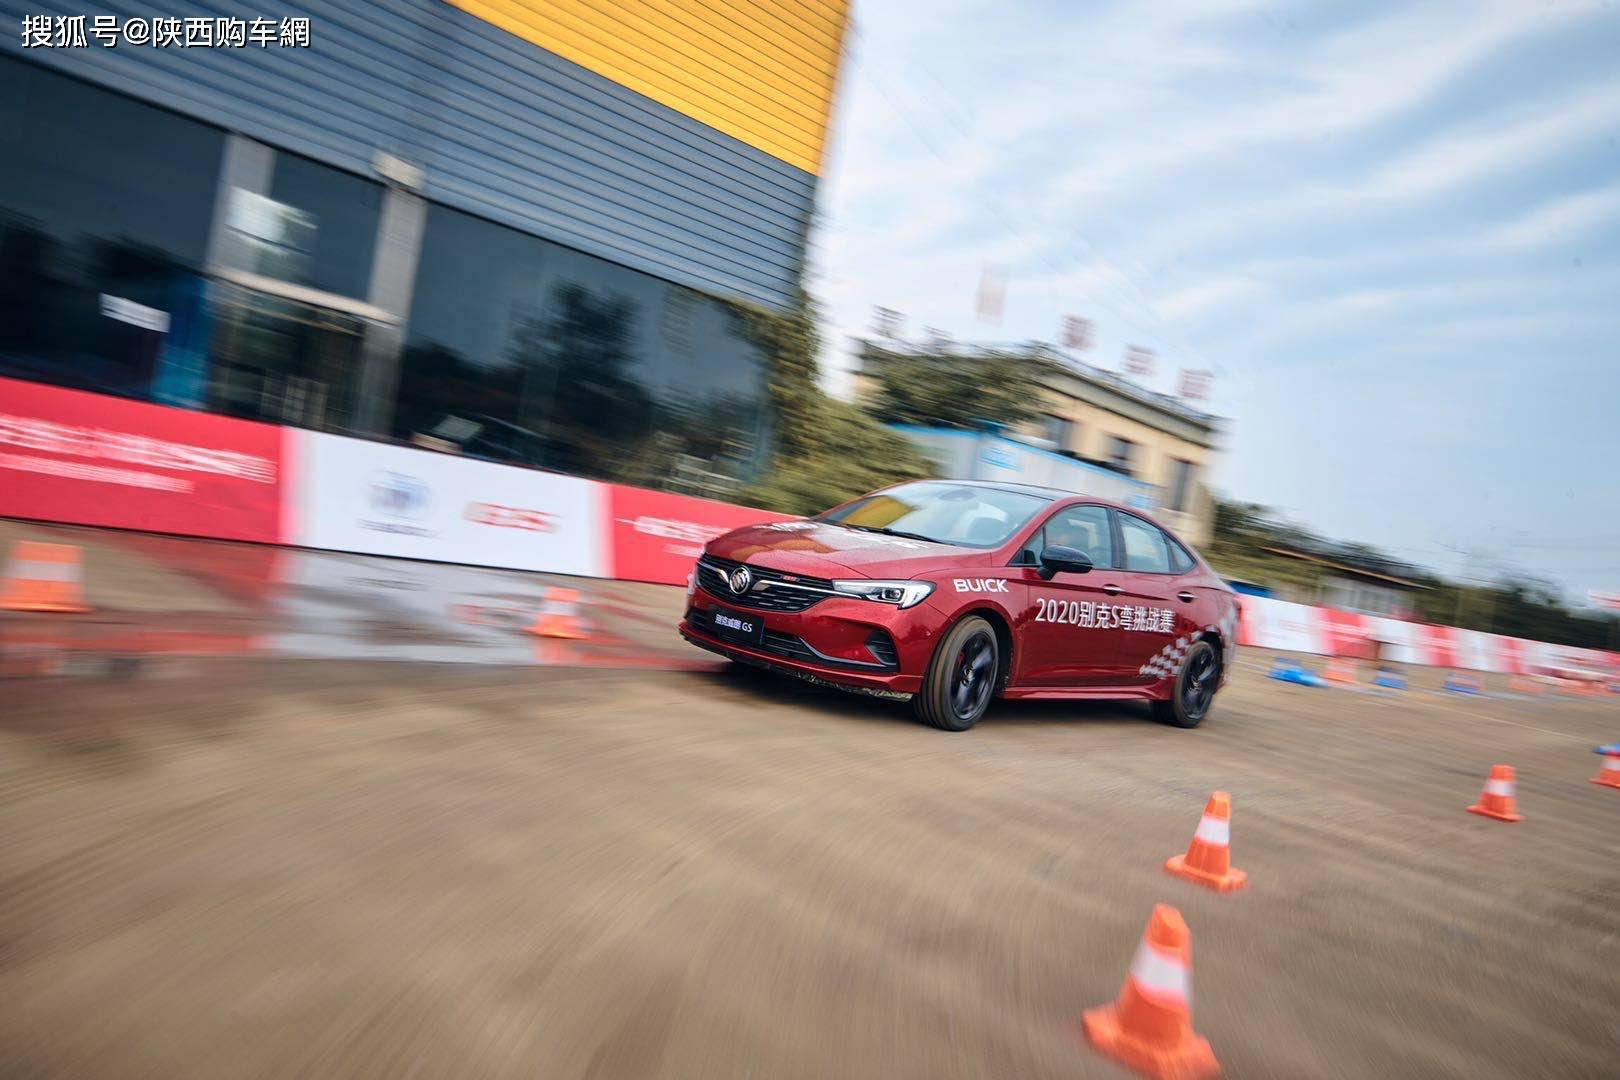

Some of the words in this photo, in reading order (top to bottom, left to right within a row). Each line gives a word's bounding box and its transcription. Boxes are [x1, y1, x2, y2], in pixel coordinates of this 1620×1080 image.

[953, 578, 1009, 593] BUICK
[1034, 598, 1176, 633] 2020别克S弯挑战赛
[741, 622, 753, 632] GS
